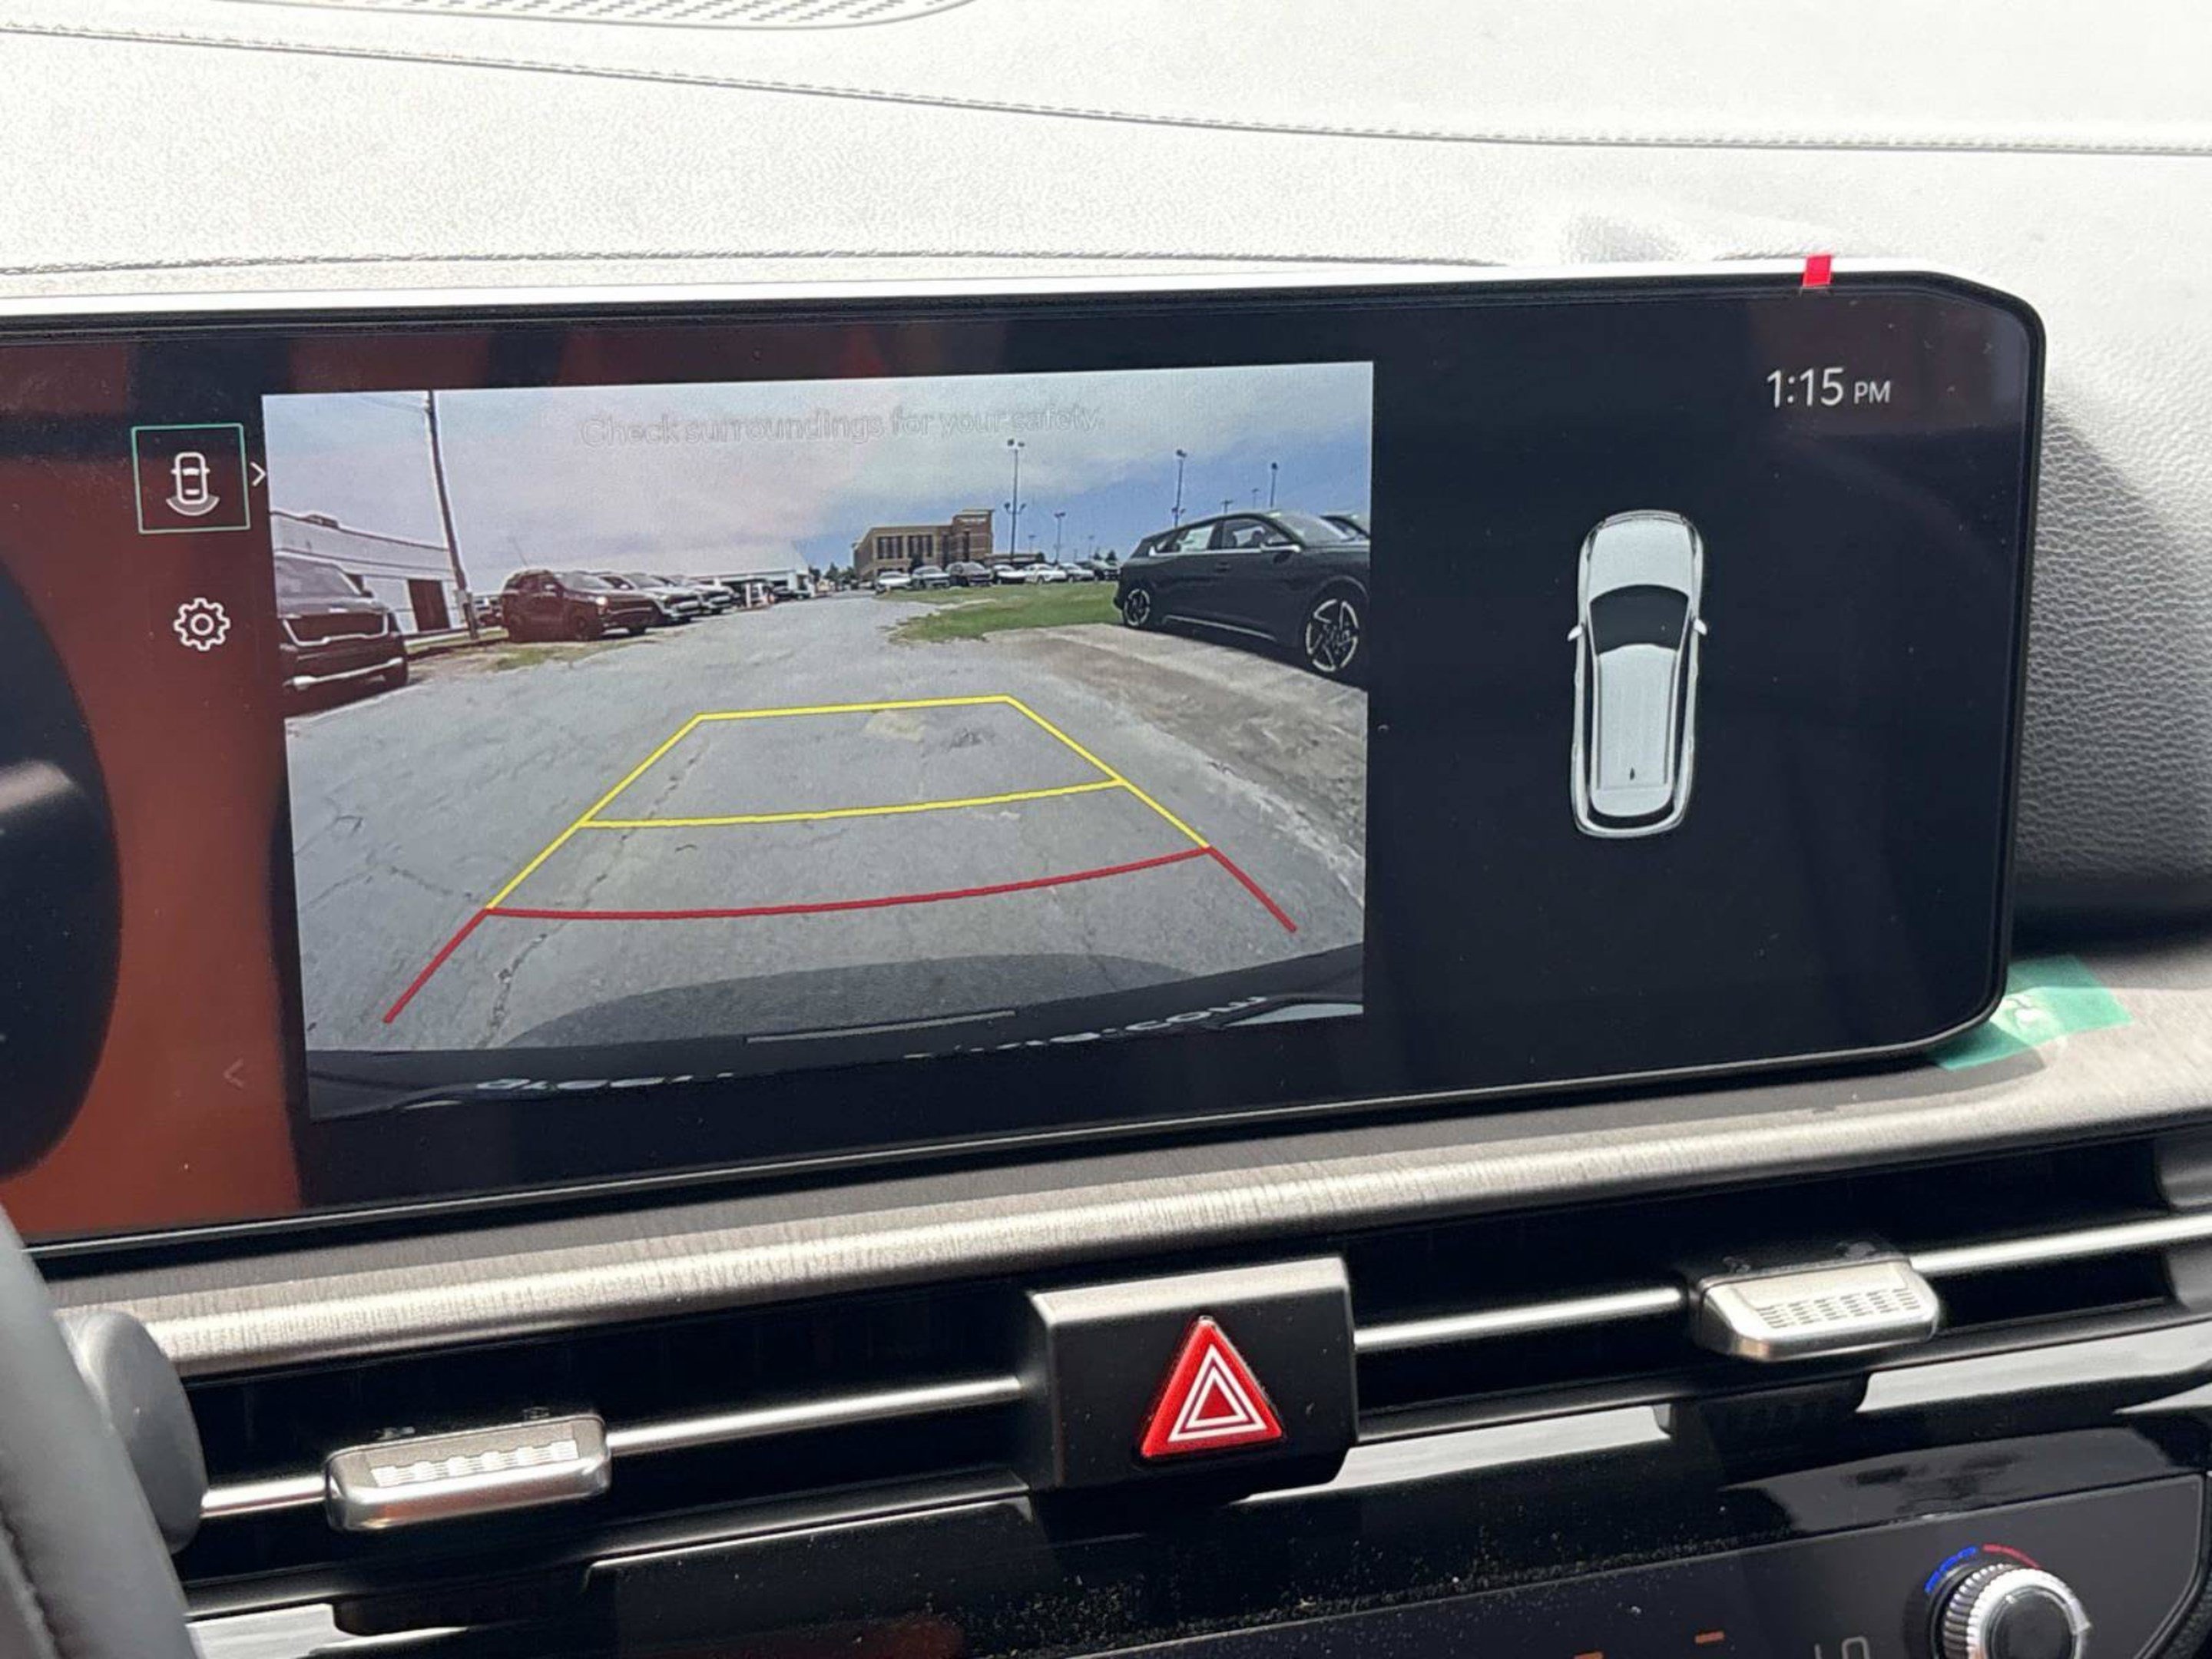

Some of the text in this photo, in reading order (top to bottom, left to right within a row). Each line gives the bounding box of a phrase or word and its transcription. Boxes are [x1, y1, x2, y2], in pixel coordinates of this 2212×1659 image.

[1767, 367, 1891, 409] 1:15 PM
[581, 402, 1106, 447] Check surroundings for your safety.
